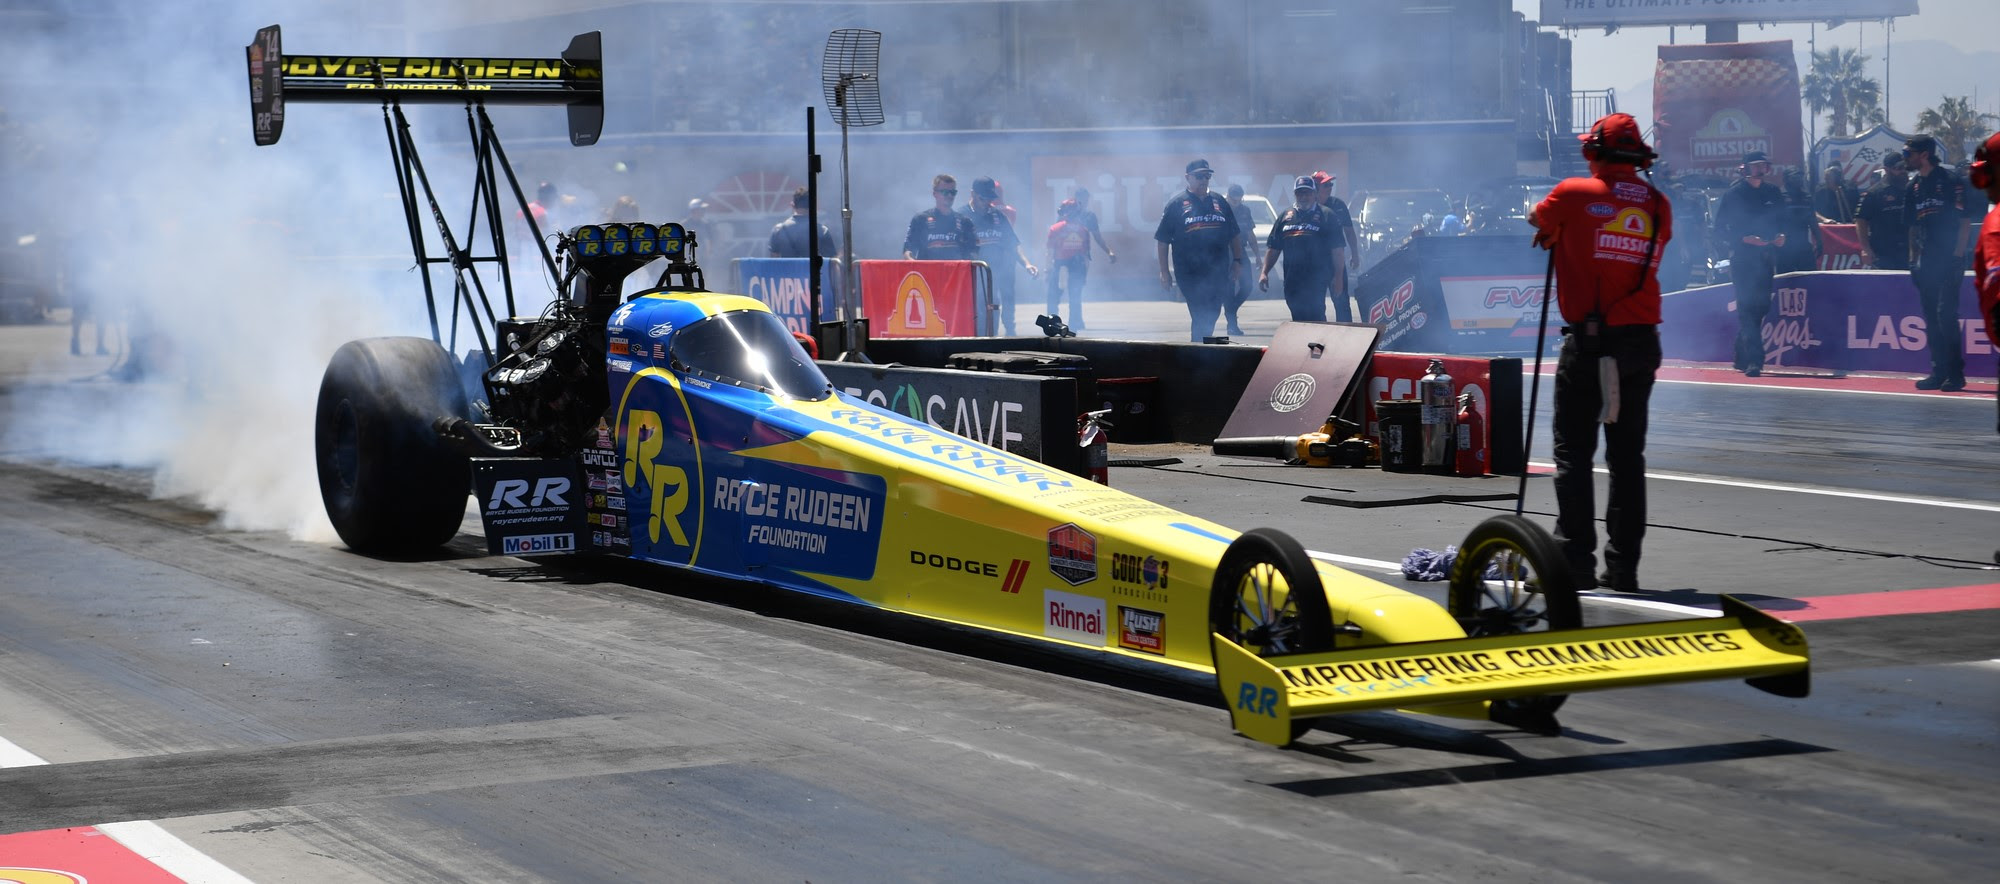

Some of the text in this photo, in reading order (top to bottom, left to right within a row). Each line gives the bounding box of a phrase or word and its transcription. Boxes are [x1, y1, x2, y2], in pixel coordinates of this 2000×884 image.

[749, 276, 824, 316] CAMPIN
[1369, 280, 1413, 324] FVP
[1484, 286, 1558, 309] FVP
[1782, 290, 1805, 313] LAS
[1847, 315, 1928, 351] LAS
[1277, 381, 1309, 405] NHRA
[488, 477, 570, 510] RR
[784, 486, 871, 532] RUDEEN
[507, 507, 531, 515] RUDEEN
[531, 505, 570, 513] FOUNDATION
[505, 537, 551, 552] Mobil
[748, 524, 827, 554] FOUNDATION
[910, 550, 999, 577] DODGE
[1112, 552, 1143, 584] CODE
[1160, 560, 1170, 589] 3
[1123, 607, 1161, 634] RUSH
[1281, 652, 1501, 690] MPOWERING
[1506, 632, 1742, 668] COMMUNITIES
[1237, 681, 1279, 718] RR
